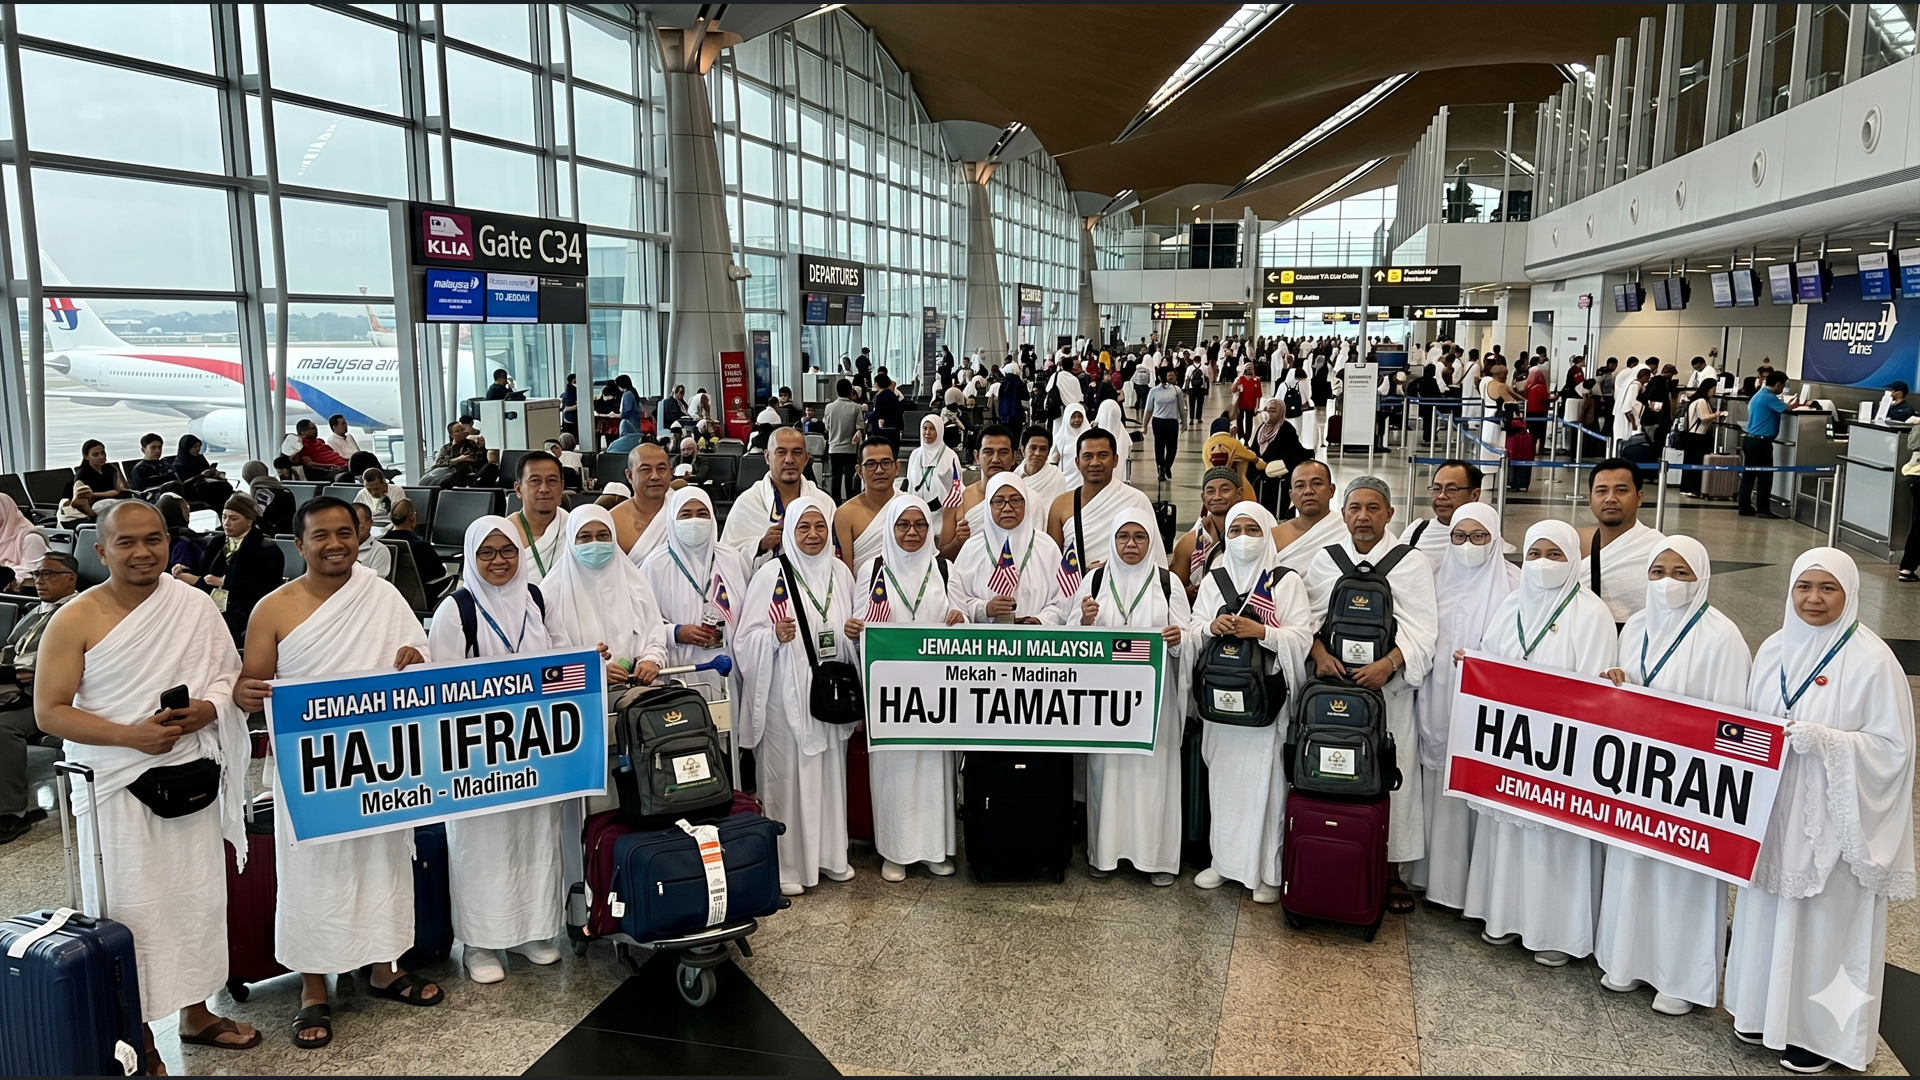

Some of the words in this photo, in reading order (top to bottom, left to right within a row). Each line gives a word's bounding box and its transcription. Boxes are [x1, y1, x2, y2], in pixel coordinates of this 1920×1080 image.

[427, 239, 471, 257] KLIA
[478, 224, 532, 260] Gate
[538, 229, 583, 265] C34
[809, 263, 859, 287] DEPARTURES
[494, 292, 504, 301] TO
[504, 292, 530, 302] JEDDAH
[1822, 317, 1877, 347] malaysia
[297, 356, 374, 374] malaysia
[919, 638, 982, 656] JEMAAH
[987, 639, 1021, 657] HAJI
[1027, 641, 1104, 658] MALAYSIA
[946, 666, 996, 681] Mekah
[1013, 667, 1077, 682] Madinah
[303, 691, 386, 721] JEMAAH
[394, 685, 435, 710] HAJI
[442, 674, 534, 702] MALAYSIA
[880, 686, 957, 724] HAJI
[970, 688, 1143, 727] TAMATTU'
[301, 723, 421, 794] HAJI
[440, 701, 581, 772] IFRAD
[1475, 704, 1578, 777] HAJI
[1593, 734, 1753, 826] QIRAN
[362, 784, 432, 815] Mekah
[453, 768, 537, 799] Madinah
[1495, 775, 1565, 811] JEMAAH
[1570, 795, 1610, 823] HAJI
[1615, 808, 1711, 855] MALAYSIA
